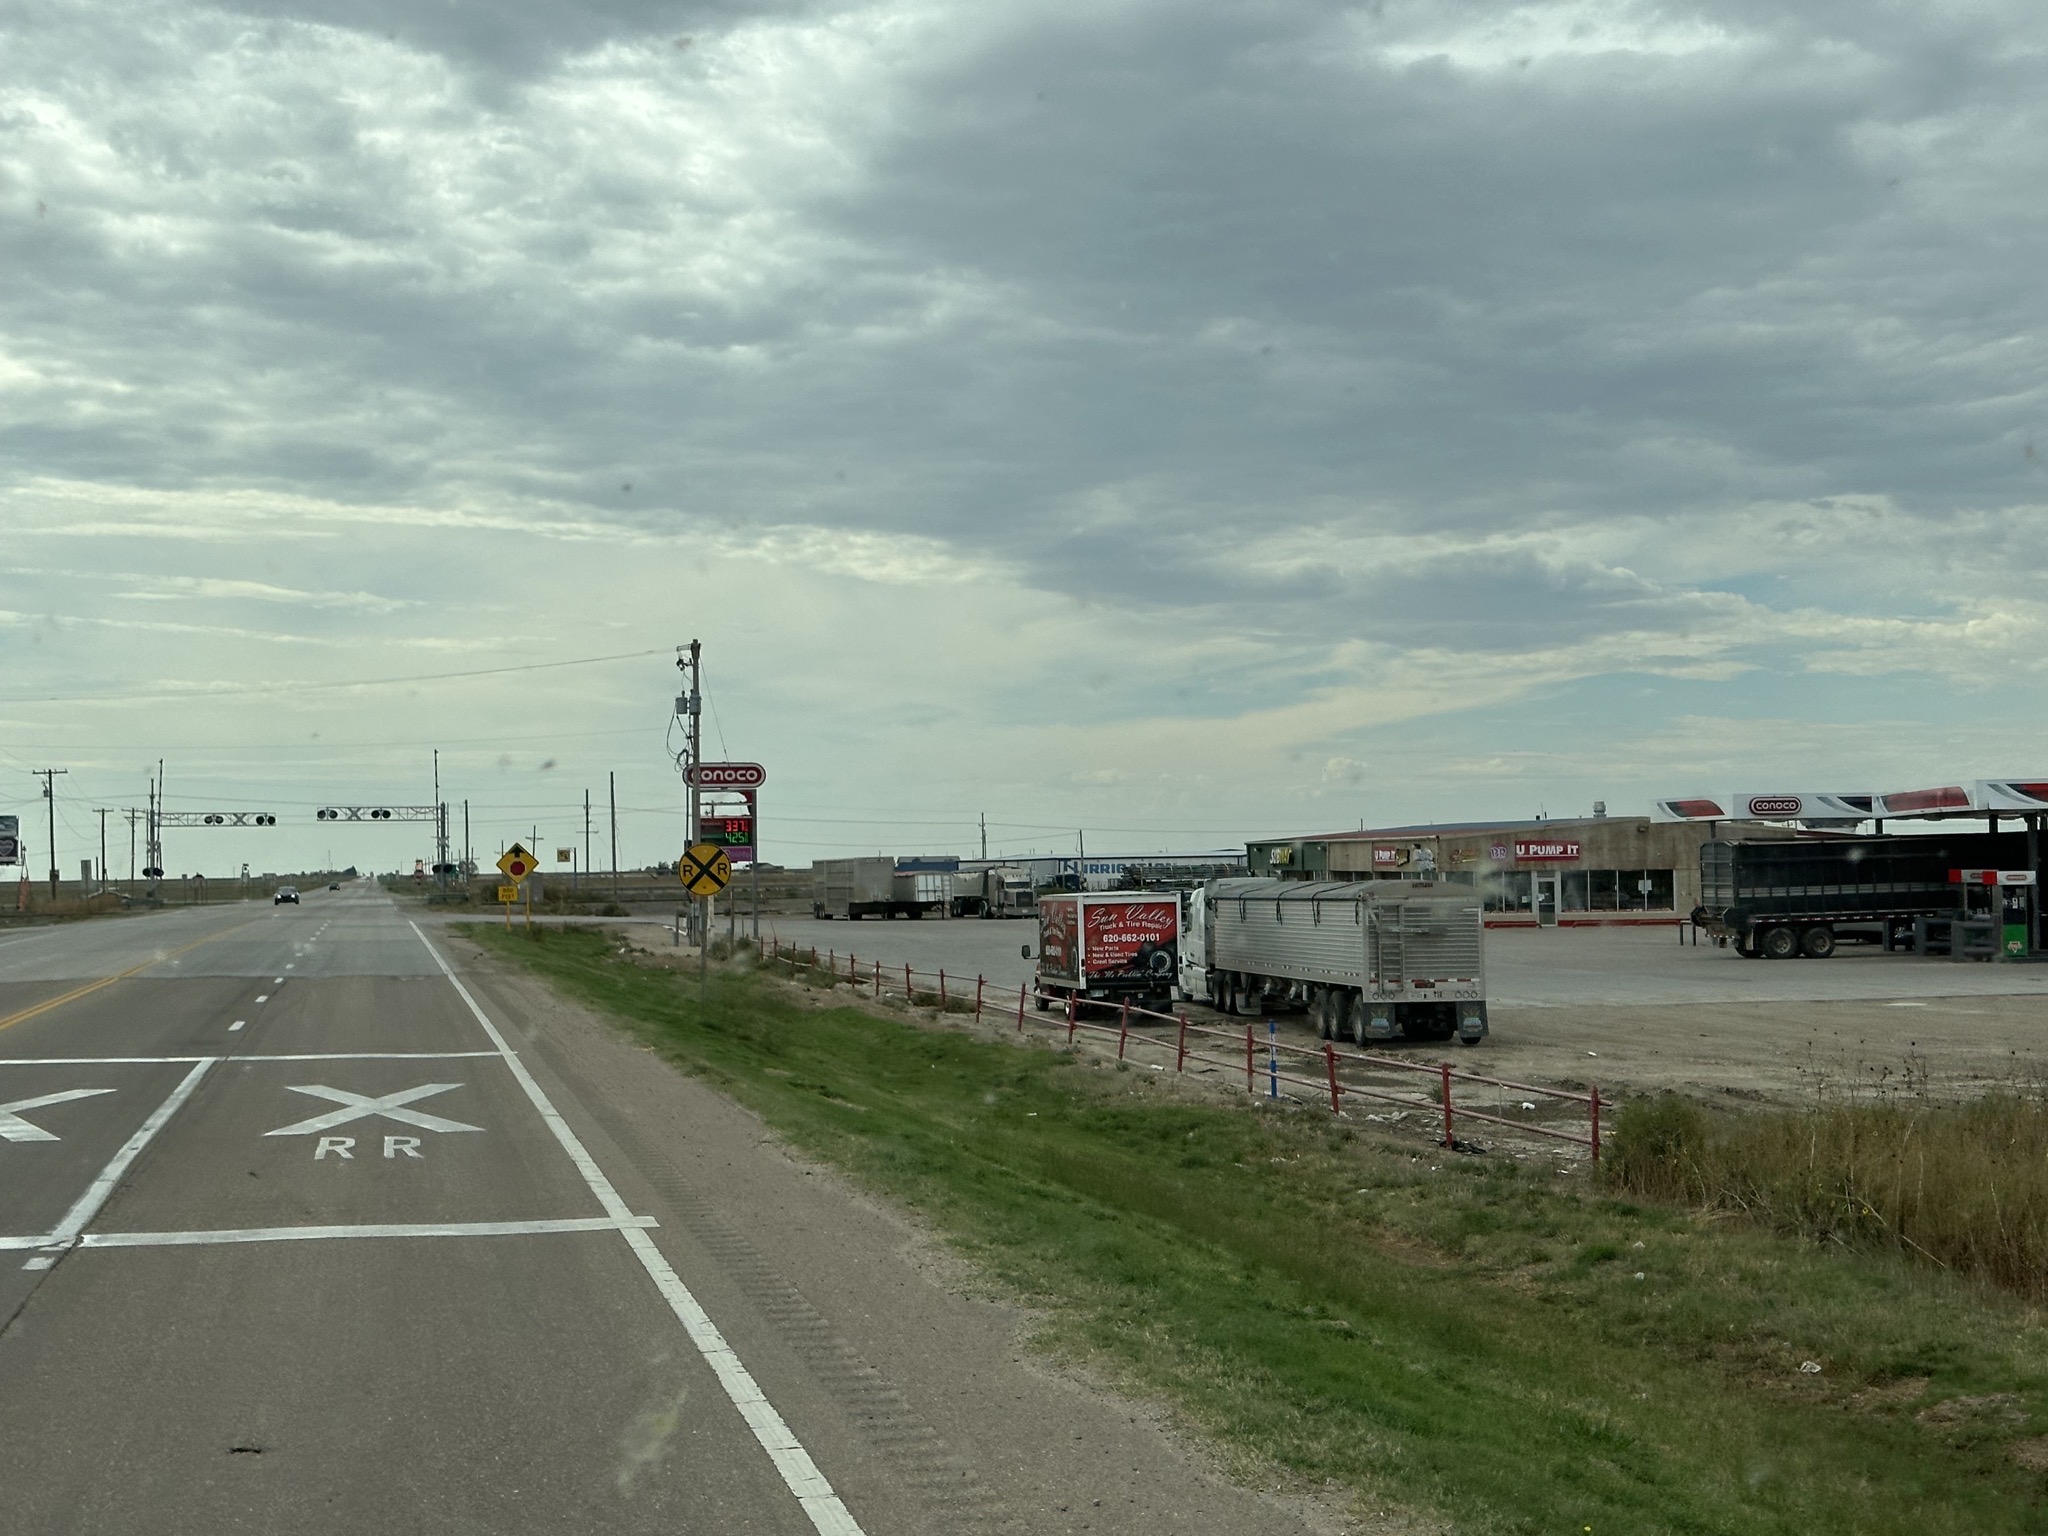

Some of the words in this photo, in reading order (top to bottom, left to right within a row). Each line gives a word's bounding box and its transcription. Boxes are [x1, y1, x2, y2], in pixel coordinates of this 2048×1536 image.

[691, 770, 758, 781] onoco
[1516, 844, 1526, 855] U
[1529, 844, 1564, 855] PUMP
[1567, 844, 1579, 854] IT
[1088, 907, 1118, 928] Sun
[1125, 904, 1174, 929] Valley
[1103, 933, 1160, 942] 620-662-0101
